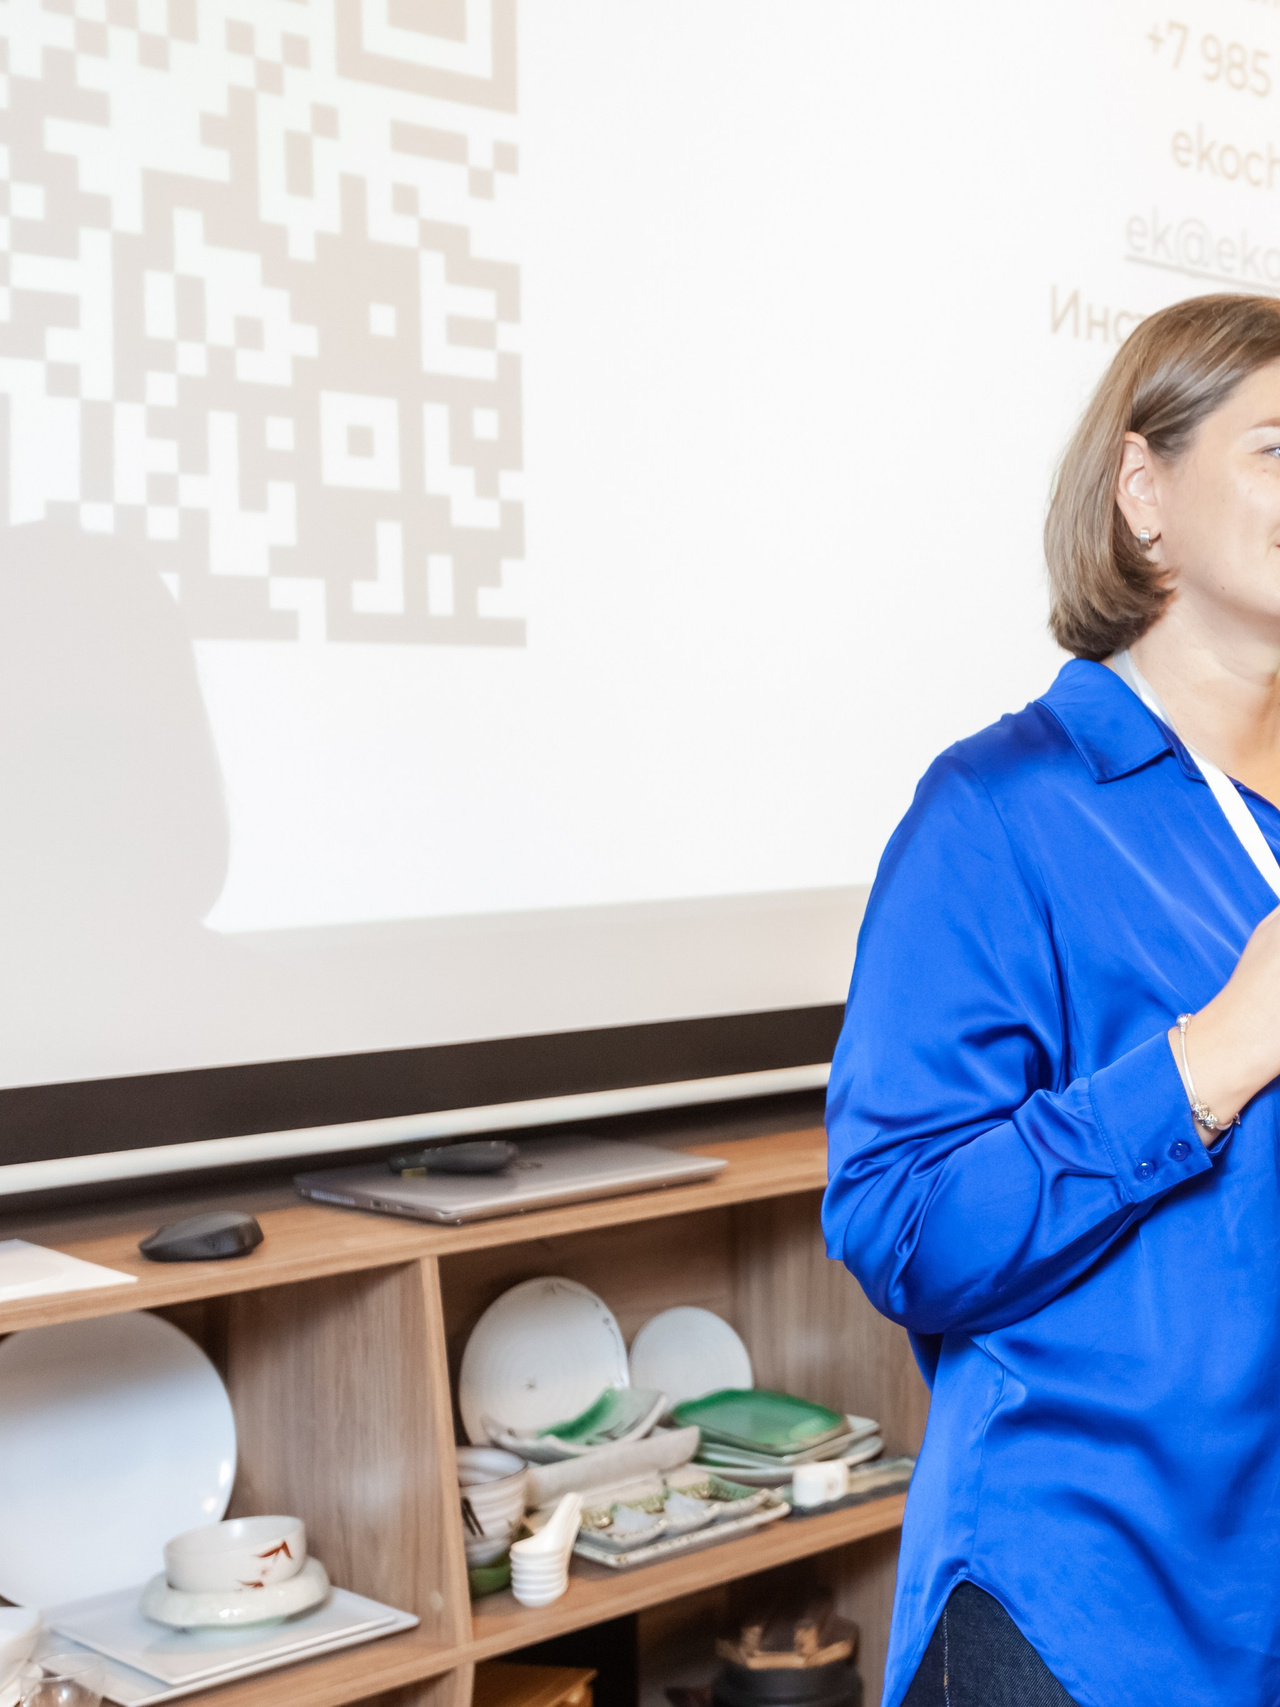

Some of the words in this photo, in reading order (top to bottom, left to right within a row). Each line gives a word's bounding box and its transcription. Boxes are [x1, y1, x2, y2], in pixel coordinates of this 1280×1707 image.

[1146, 20, 1188, 69] +7
[1200, 33, 1272, 98] 985
[1049, 284, 1148, 346] Инс
